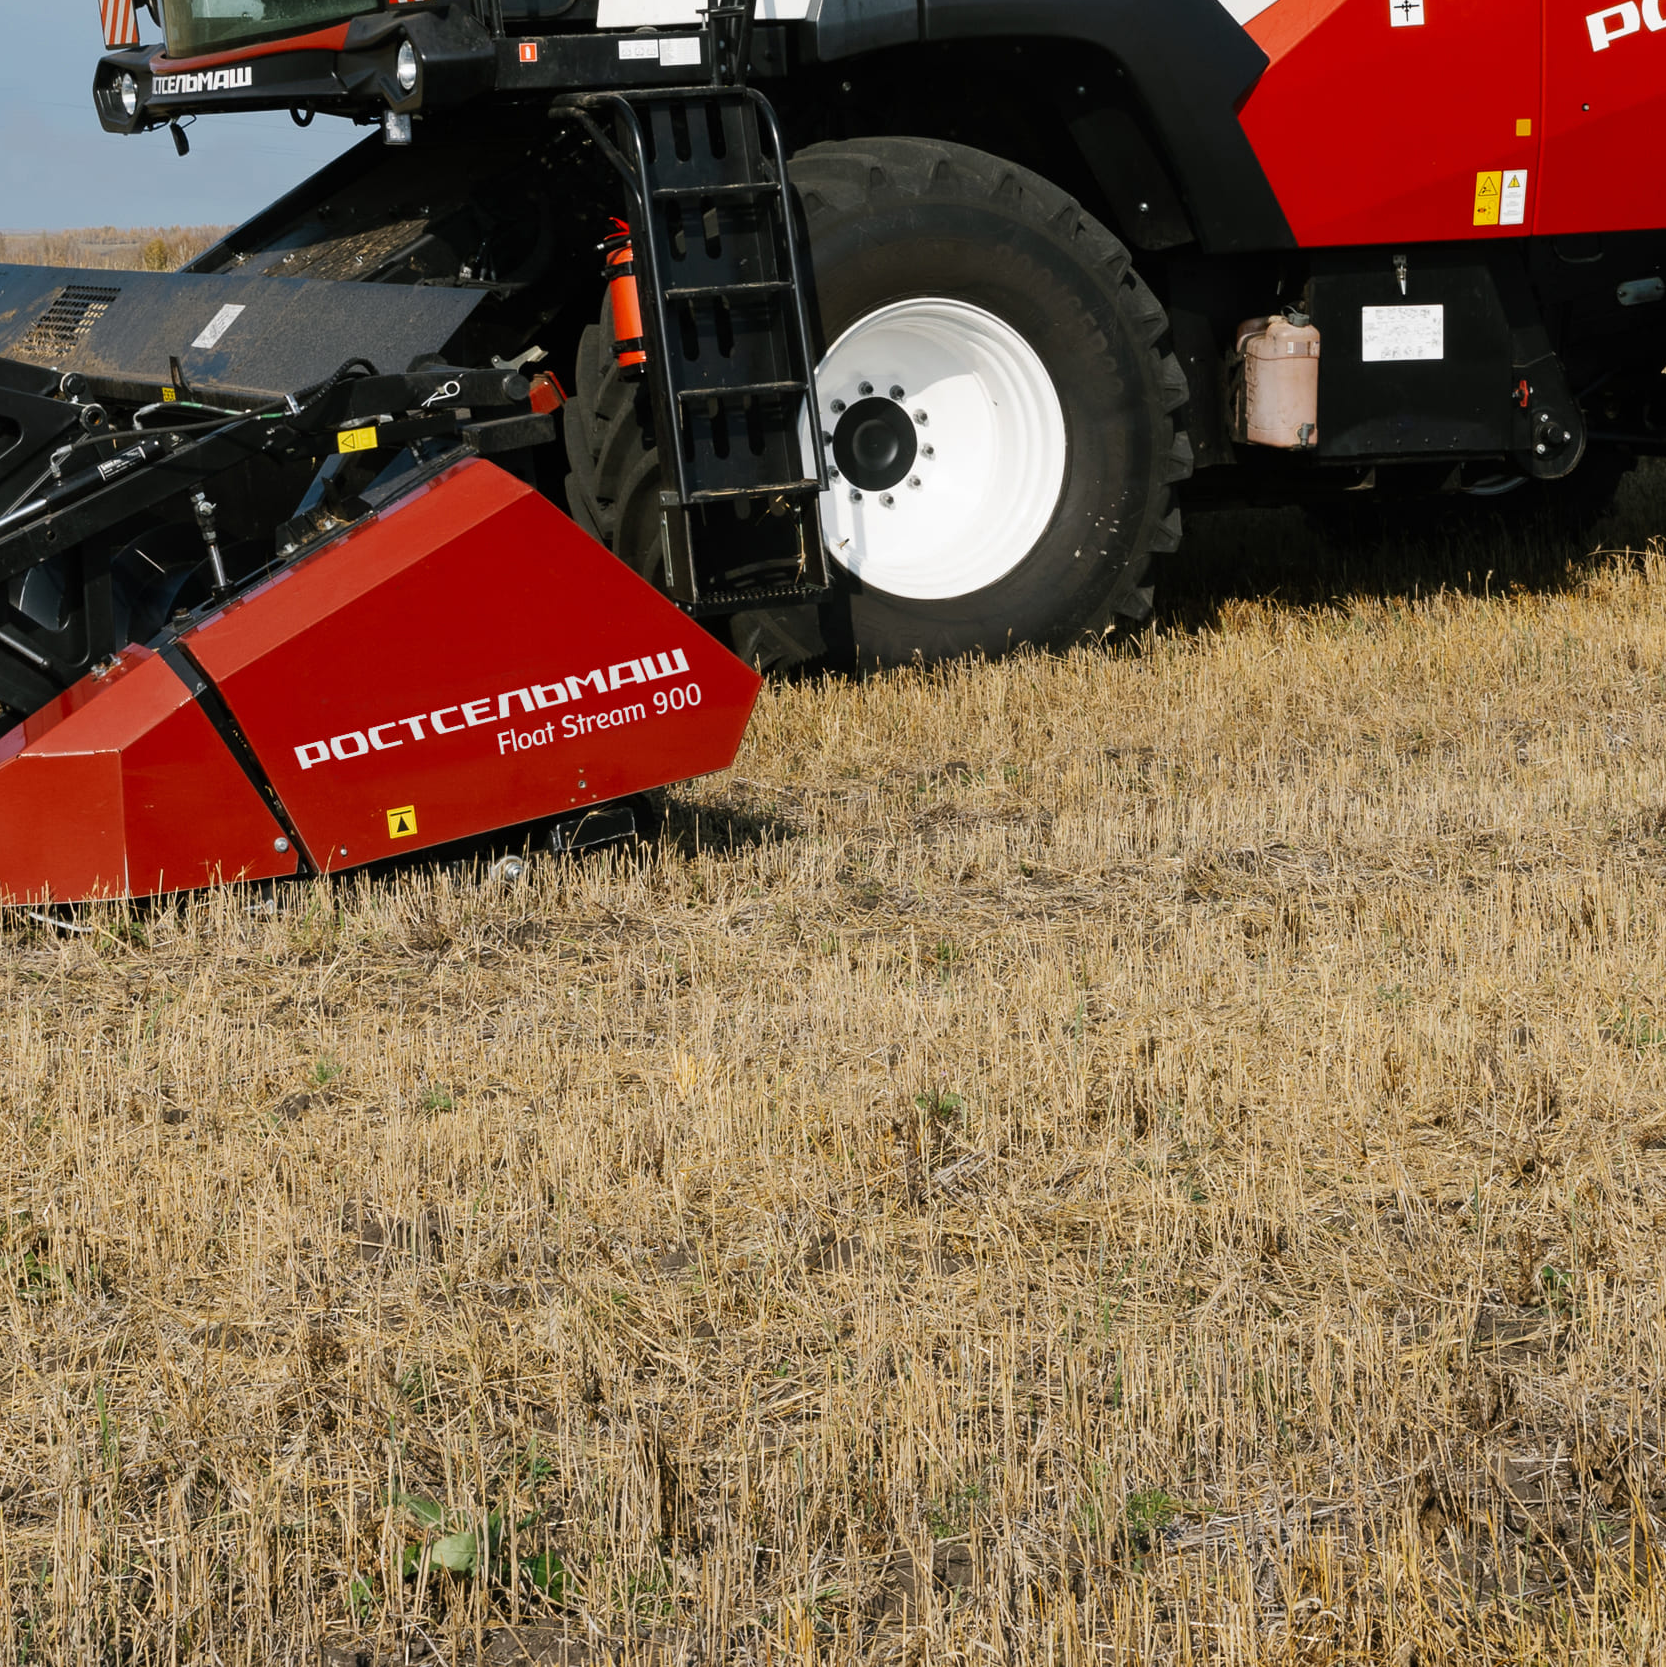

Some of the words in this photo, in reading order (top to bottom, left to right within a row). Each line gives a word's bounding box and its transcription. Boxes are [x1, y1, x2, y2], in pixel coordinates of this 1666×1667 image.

[293, 647, 690, 770] РОСТСЕЛЬМАШ
[497, 721, 555, 755] Float
[562, 701, 647, 740] Stream
[652, 682, 703, 716] 900
